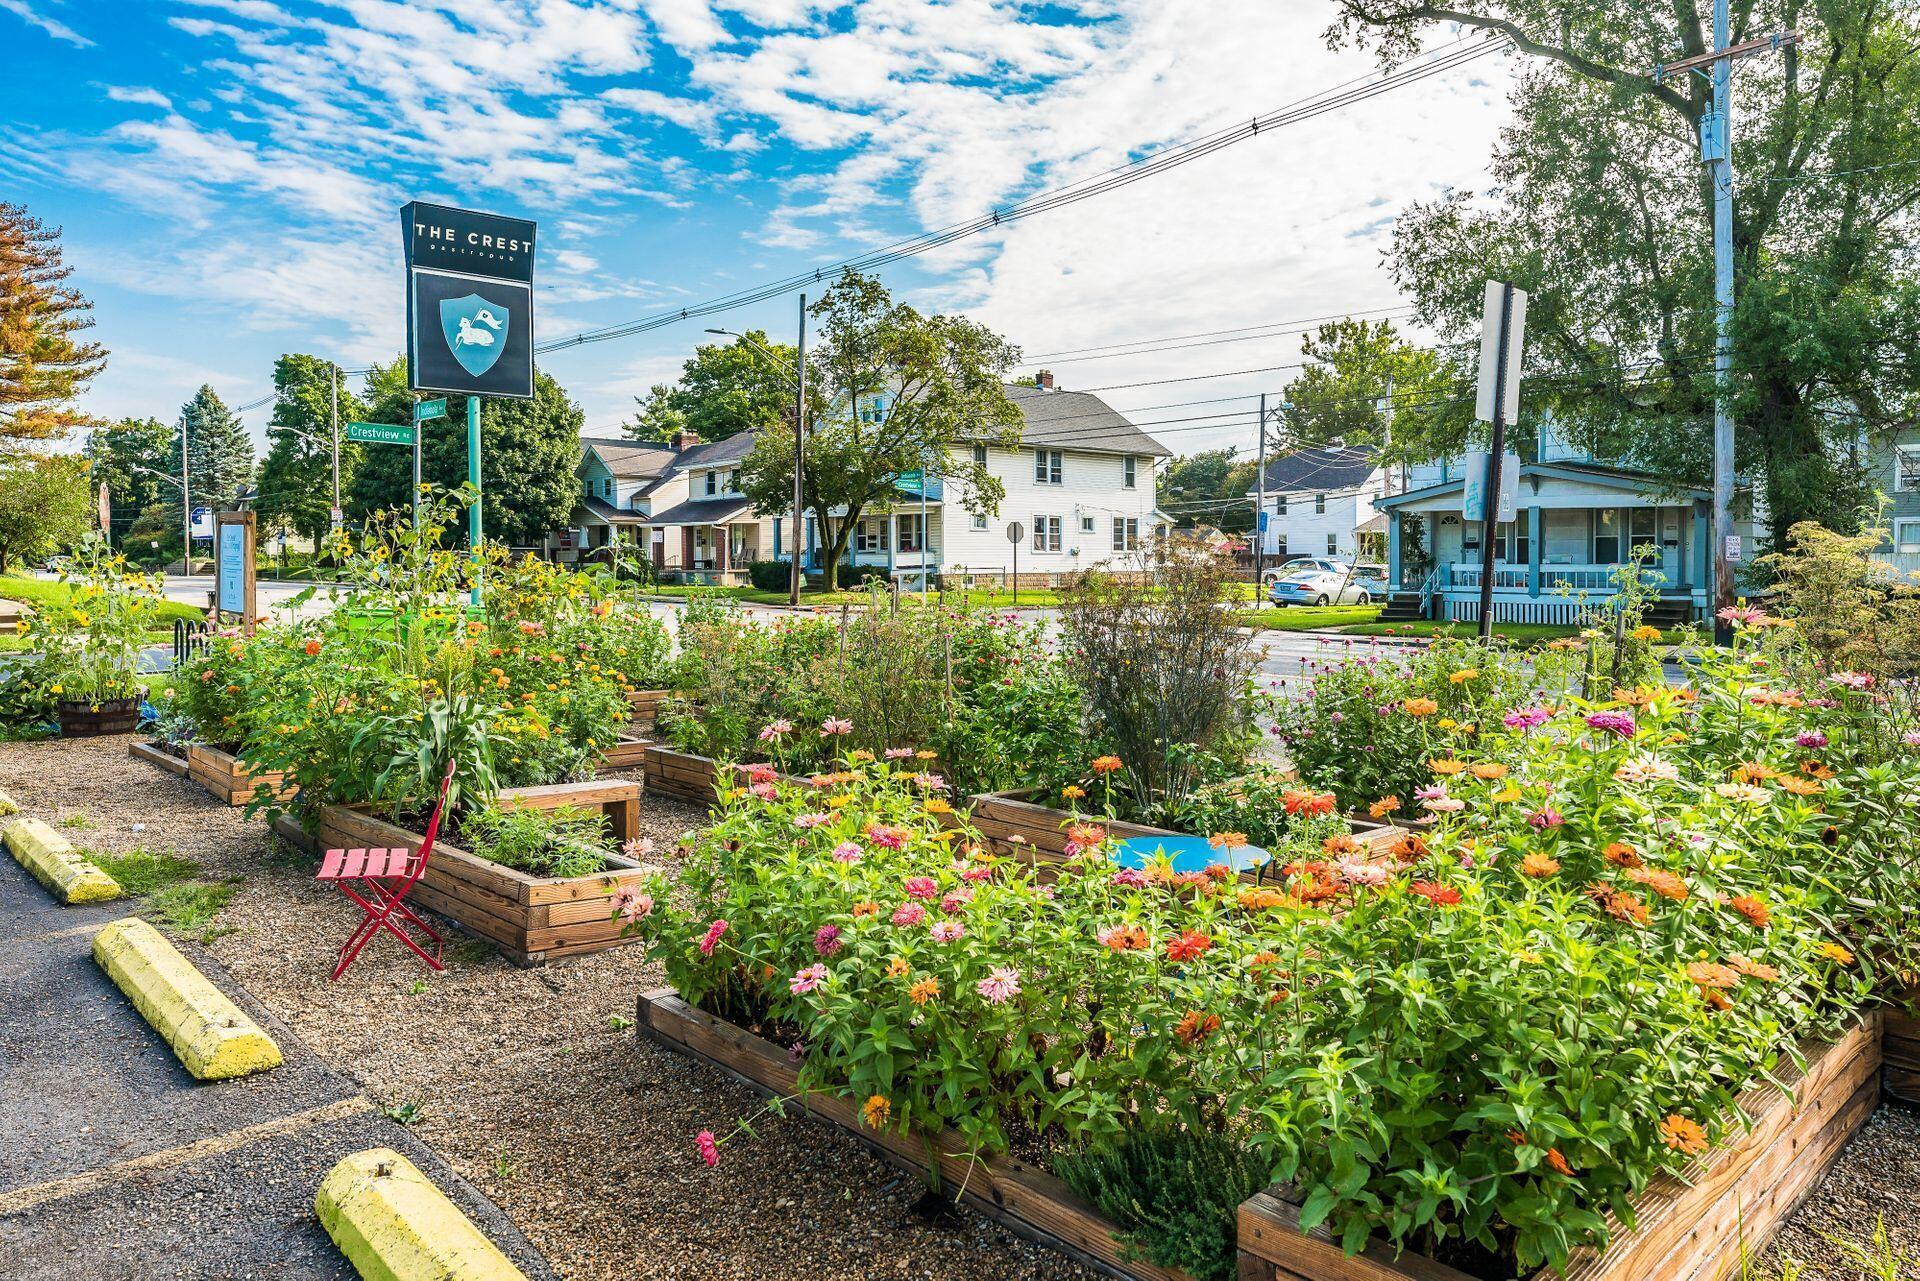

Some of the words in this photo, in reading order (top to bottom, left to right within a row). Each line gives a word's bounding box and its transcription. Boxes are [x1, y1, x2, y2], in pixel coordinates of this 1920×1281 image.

[415, 223, 455, 241] THE
[467, 232, 531, 253] CREST
[430, 244, 514, 262] gastropub
[351, 425, 399, 440] Crestview
